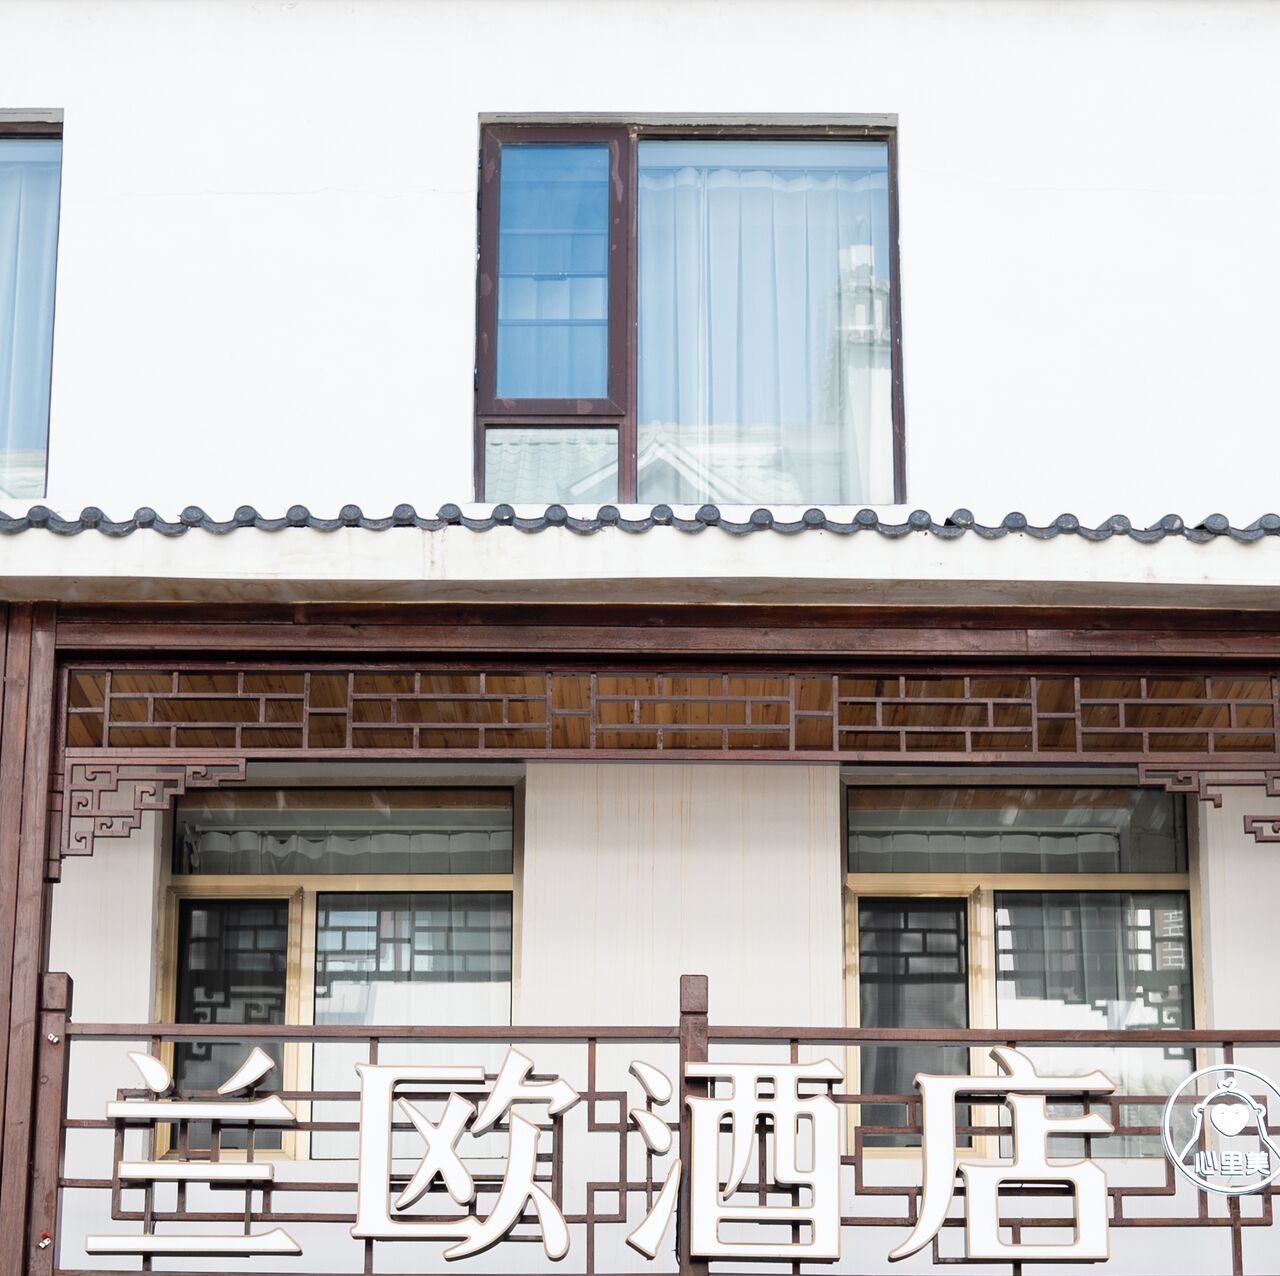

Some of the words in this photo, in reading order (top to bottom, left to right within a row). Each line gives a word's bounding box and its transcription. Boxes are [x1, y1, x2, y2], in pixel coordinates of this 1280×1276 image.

[86, 1045, 1117, 1262] 兰欧酒店
[1194, 1151, 1270, 1177] 心里美
